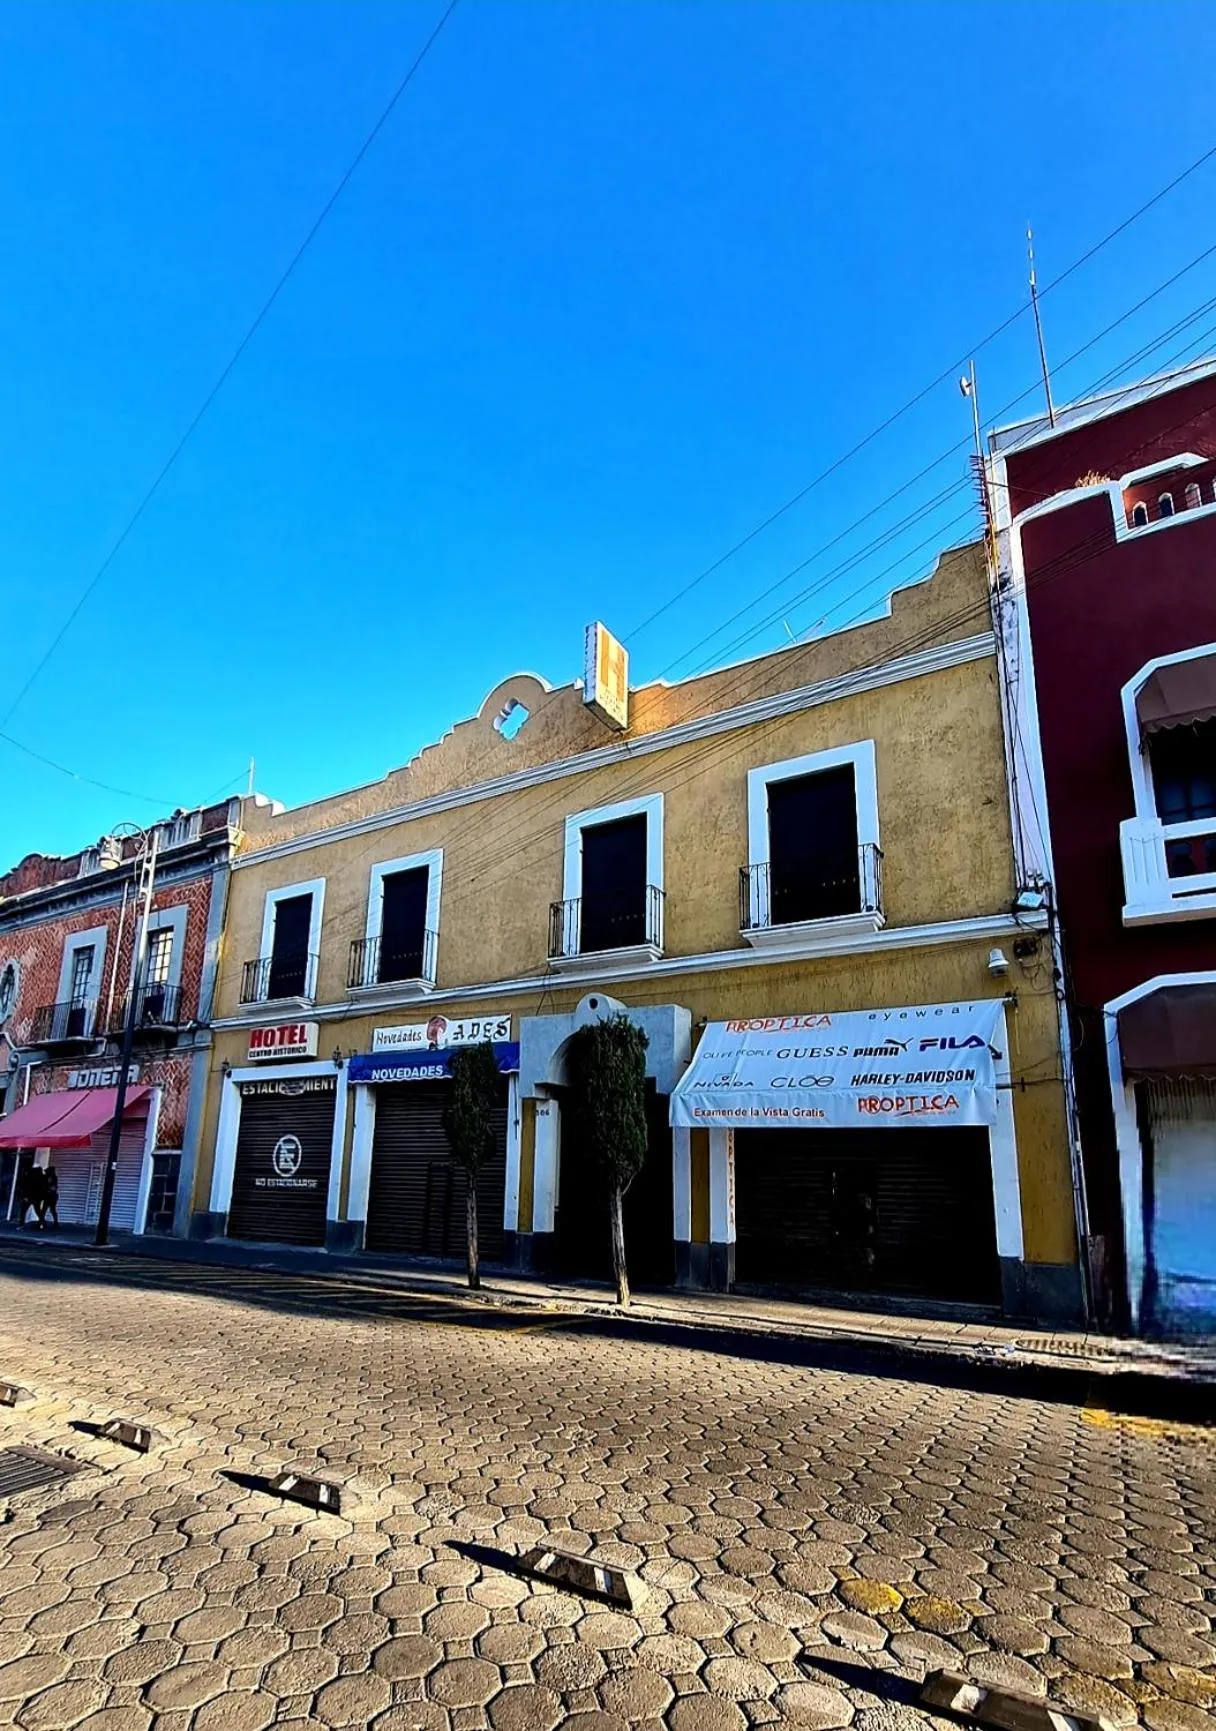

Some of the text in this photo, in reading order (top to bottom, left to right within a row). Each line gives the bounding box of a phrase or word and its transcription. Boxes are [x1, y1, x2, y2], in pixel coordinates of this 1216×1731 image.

[868, 1005, 975, 1020] eyewear
[250, 1024, 307, 1049] HOTEL
[376, 1029, 422, 1045] Novedades
[919, 1035, 985, 1051] FILA
[249, 1048, 272, 1058] CENTRO
[776, 1045, 849, 1059] GUESS
[371, 1065, 444, 1080] NOVEDADES
[693, 1080, 754, 1088] NIVADA
[851, 1069, 976, 1086] HARLEY-DAVIDSON
[242, 1078, 336, 1095] ESTACIMIENT
[694, 1107, 825, 1118] Examen de la Vista Gratis
[727, 1127, 735, 1224] OPTICA
